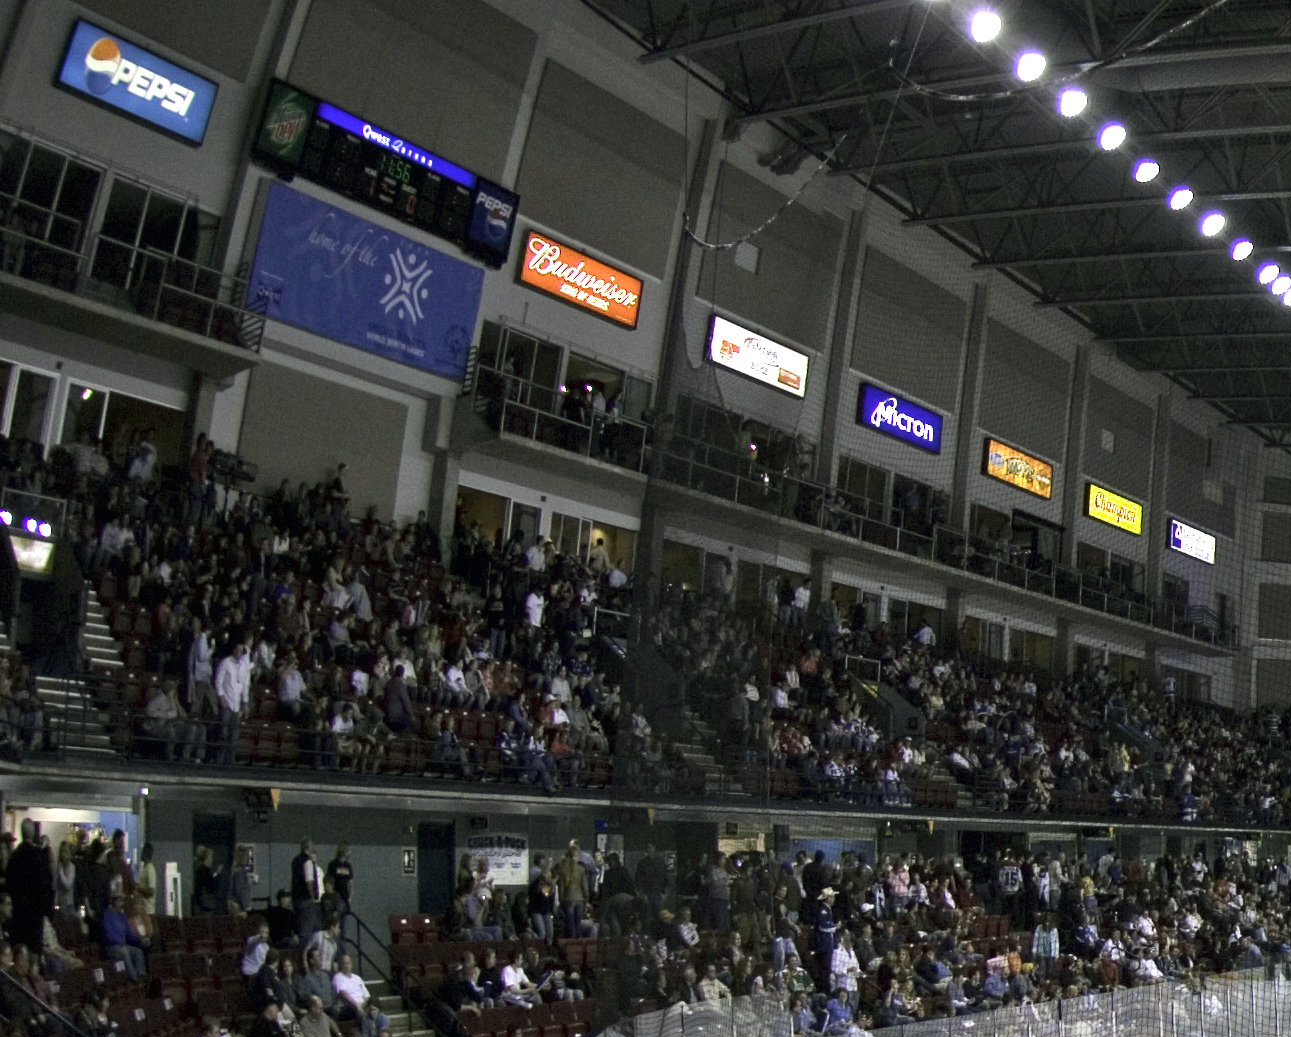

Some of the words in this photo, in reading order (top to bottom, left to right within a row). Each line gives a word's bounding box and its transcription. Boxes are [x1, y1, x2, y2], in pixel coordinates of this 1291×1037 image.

[111, 58, 195, 116] PEPSI
[476, 191, 513, 218] PEPSI
[528, 238, 638, 308] Budweiser
[870, 397, 934, 442] Micron
